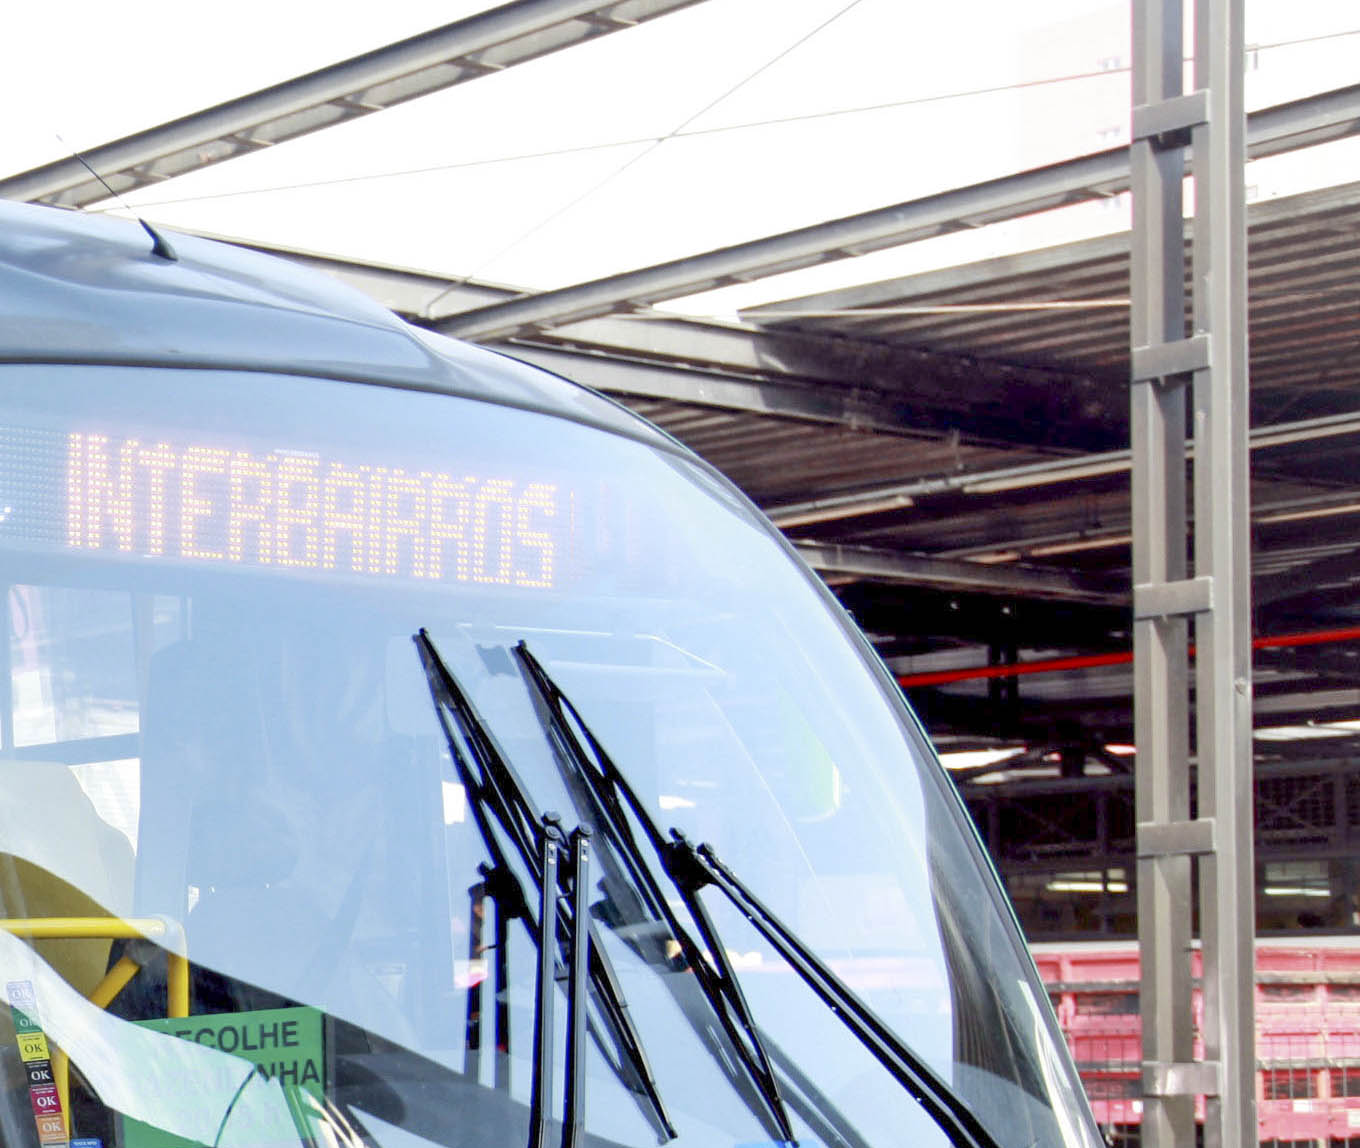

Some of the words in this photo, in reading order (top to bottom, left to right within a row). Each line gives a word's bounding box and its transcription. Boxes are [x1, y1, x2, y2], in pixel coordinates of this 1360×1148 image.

[67, 432, 556, 588] INTERBAIRROS
[24, 1043, 42, 1054] OK
[31, 1070, 50, 1081] OK
[37, 1096, 56, 1107] OK
[42, 1121, 61, 1133] OK
